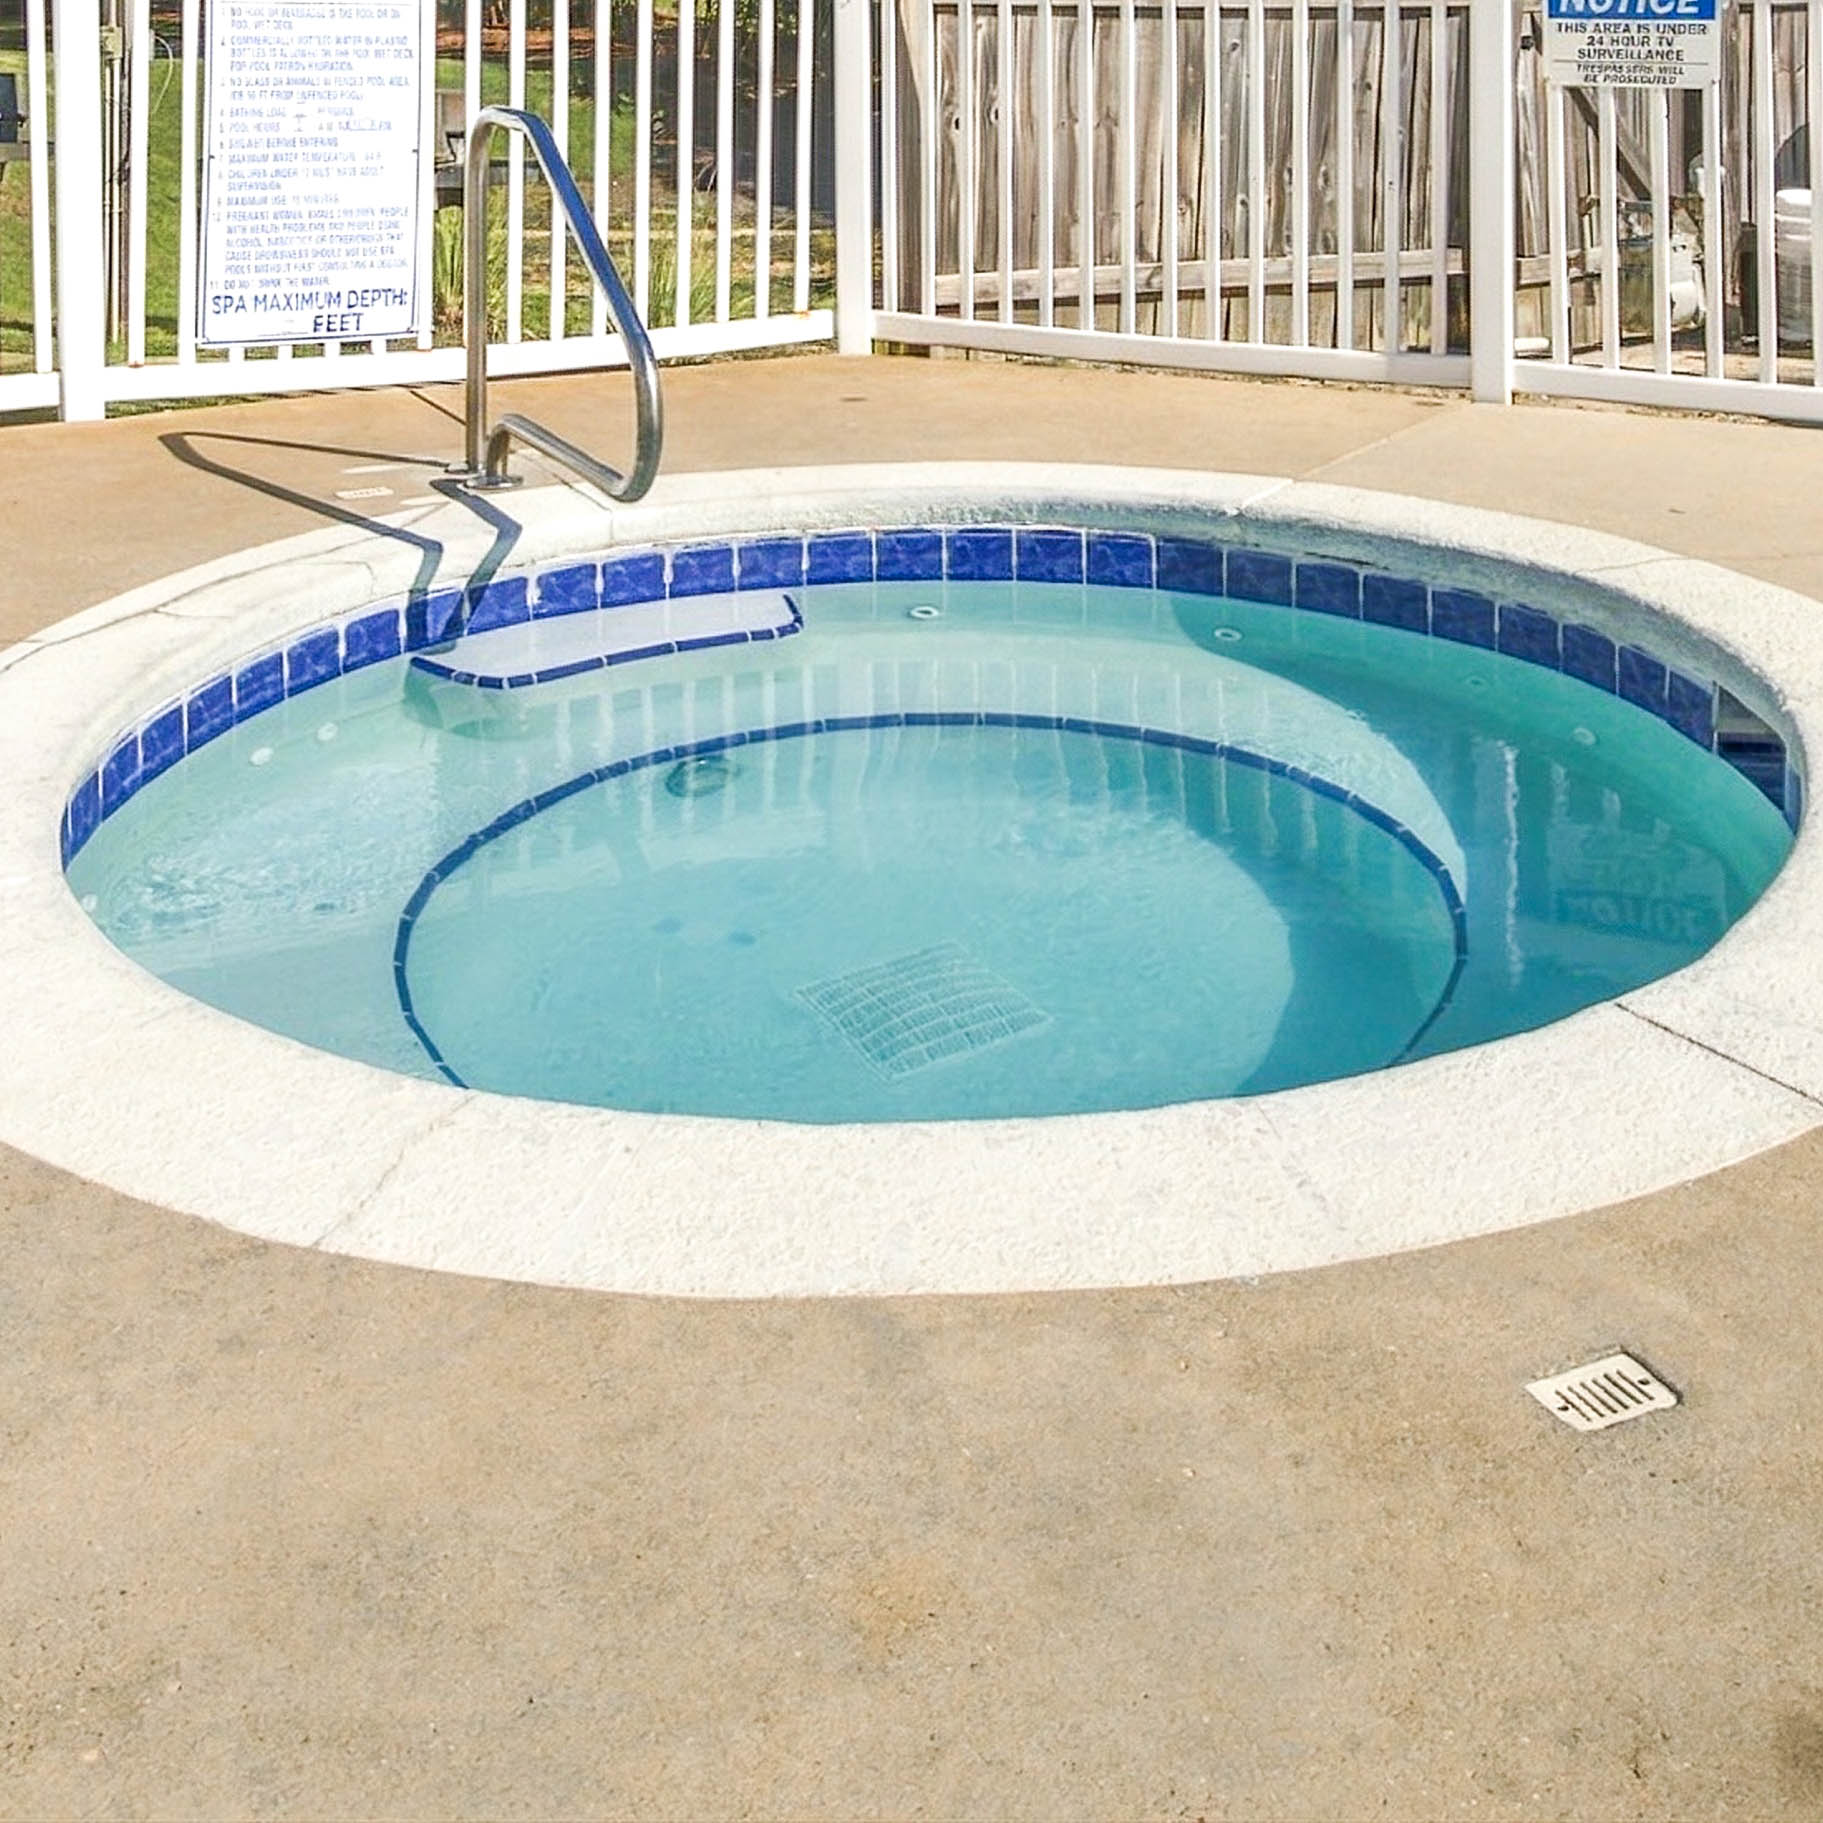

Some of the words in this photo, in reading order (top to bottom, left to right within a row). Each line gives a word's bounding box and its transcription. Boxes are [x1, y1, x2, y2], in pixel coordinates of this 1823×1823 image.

[1557, 23, 1587, 34] THIS
[1593, 23, 1631, 34] AREA
[1637, 23, 1650, 34] IS
[1657, 23, 1708, 35] UNDER
[1587, 36, 1604, 46] 24
[1610, 36, 1651, 46] HOUR
[1658, 36, 1674, 47] TV
[1578, 49, 1684, 61] SURVEILLANCE
[1577, 64, 1654, 73] TRESPASSERS
[1659, 65, 1684, 75] WILL
[1584, 75, 1598, 83] BE
[1603, 75, 1677, 84] PROSECUTED
[212, 295, 247, 314] SPA
[254, 291, 341, 312] MAXIMUM
[348, 288, 408, 309] DEPTH:
[313, 313, 363, 333] FEET
